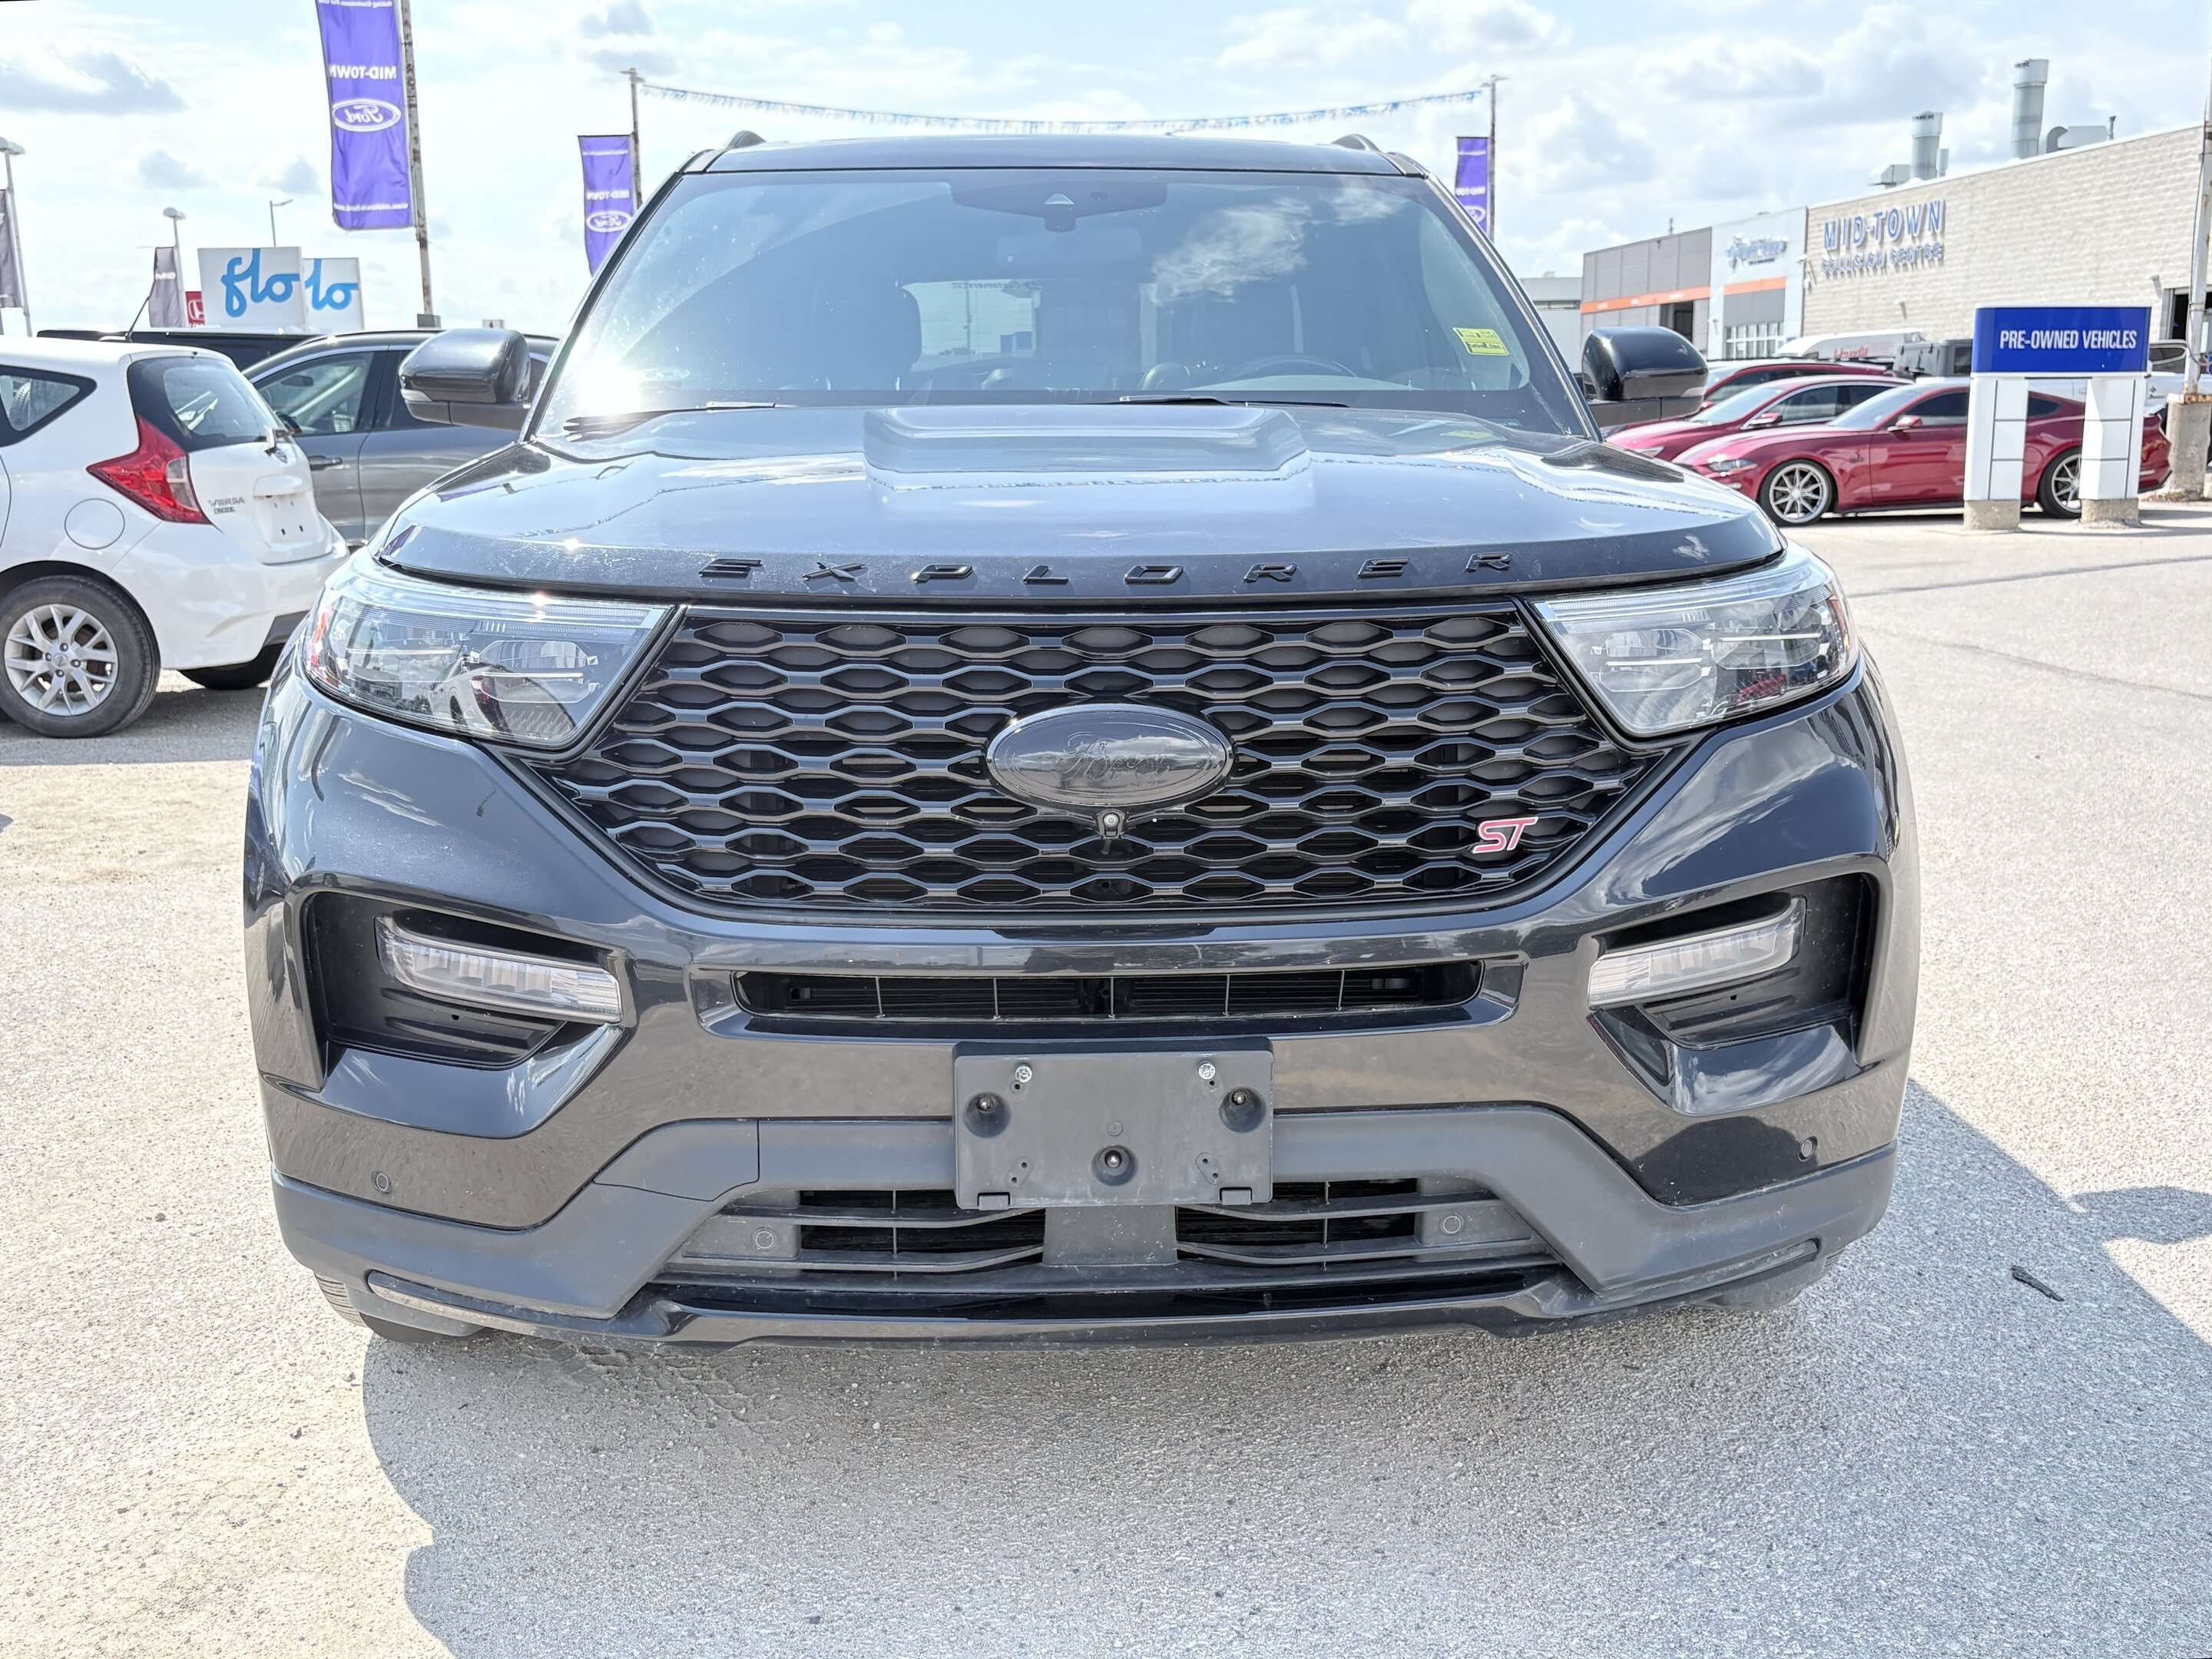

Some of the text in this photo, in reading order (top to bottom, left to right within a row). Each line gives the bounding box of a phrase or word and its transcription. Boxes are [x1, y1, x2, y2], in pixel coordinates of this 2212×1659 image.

[1823, 200, 1943, 250] MID-TOWN
[221, 248, 300, 318] flo
[304, 258, 359, 310] lo
[1999, 329, 2137, 349] PRE-OWNED VEHICLES
[699, 552, 1513, 584] EXPLORER
[1472, 816, 1539, 854] ST
